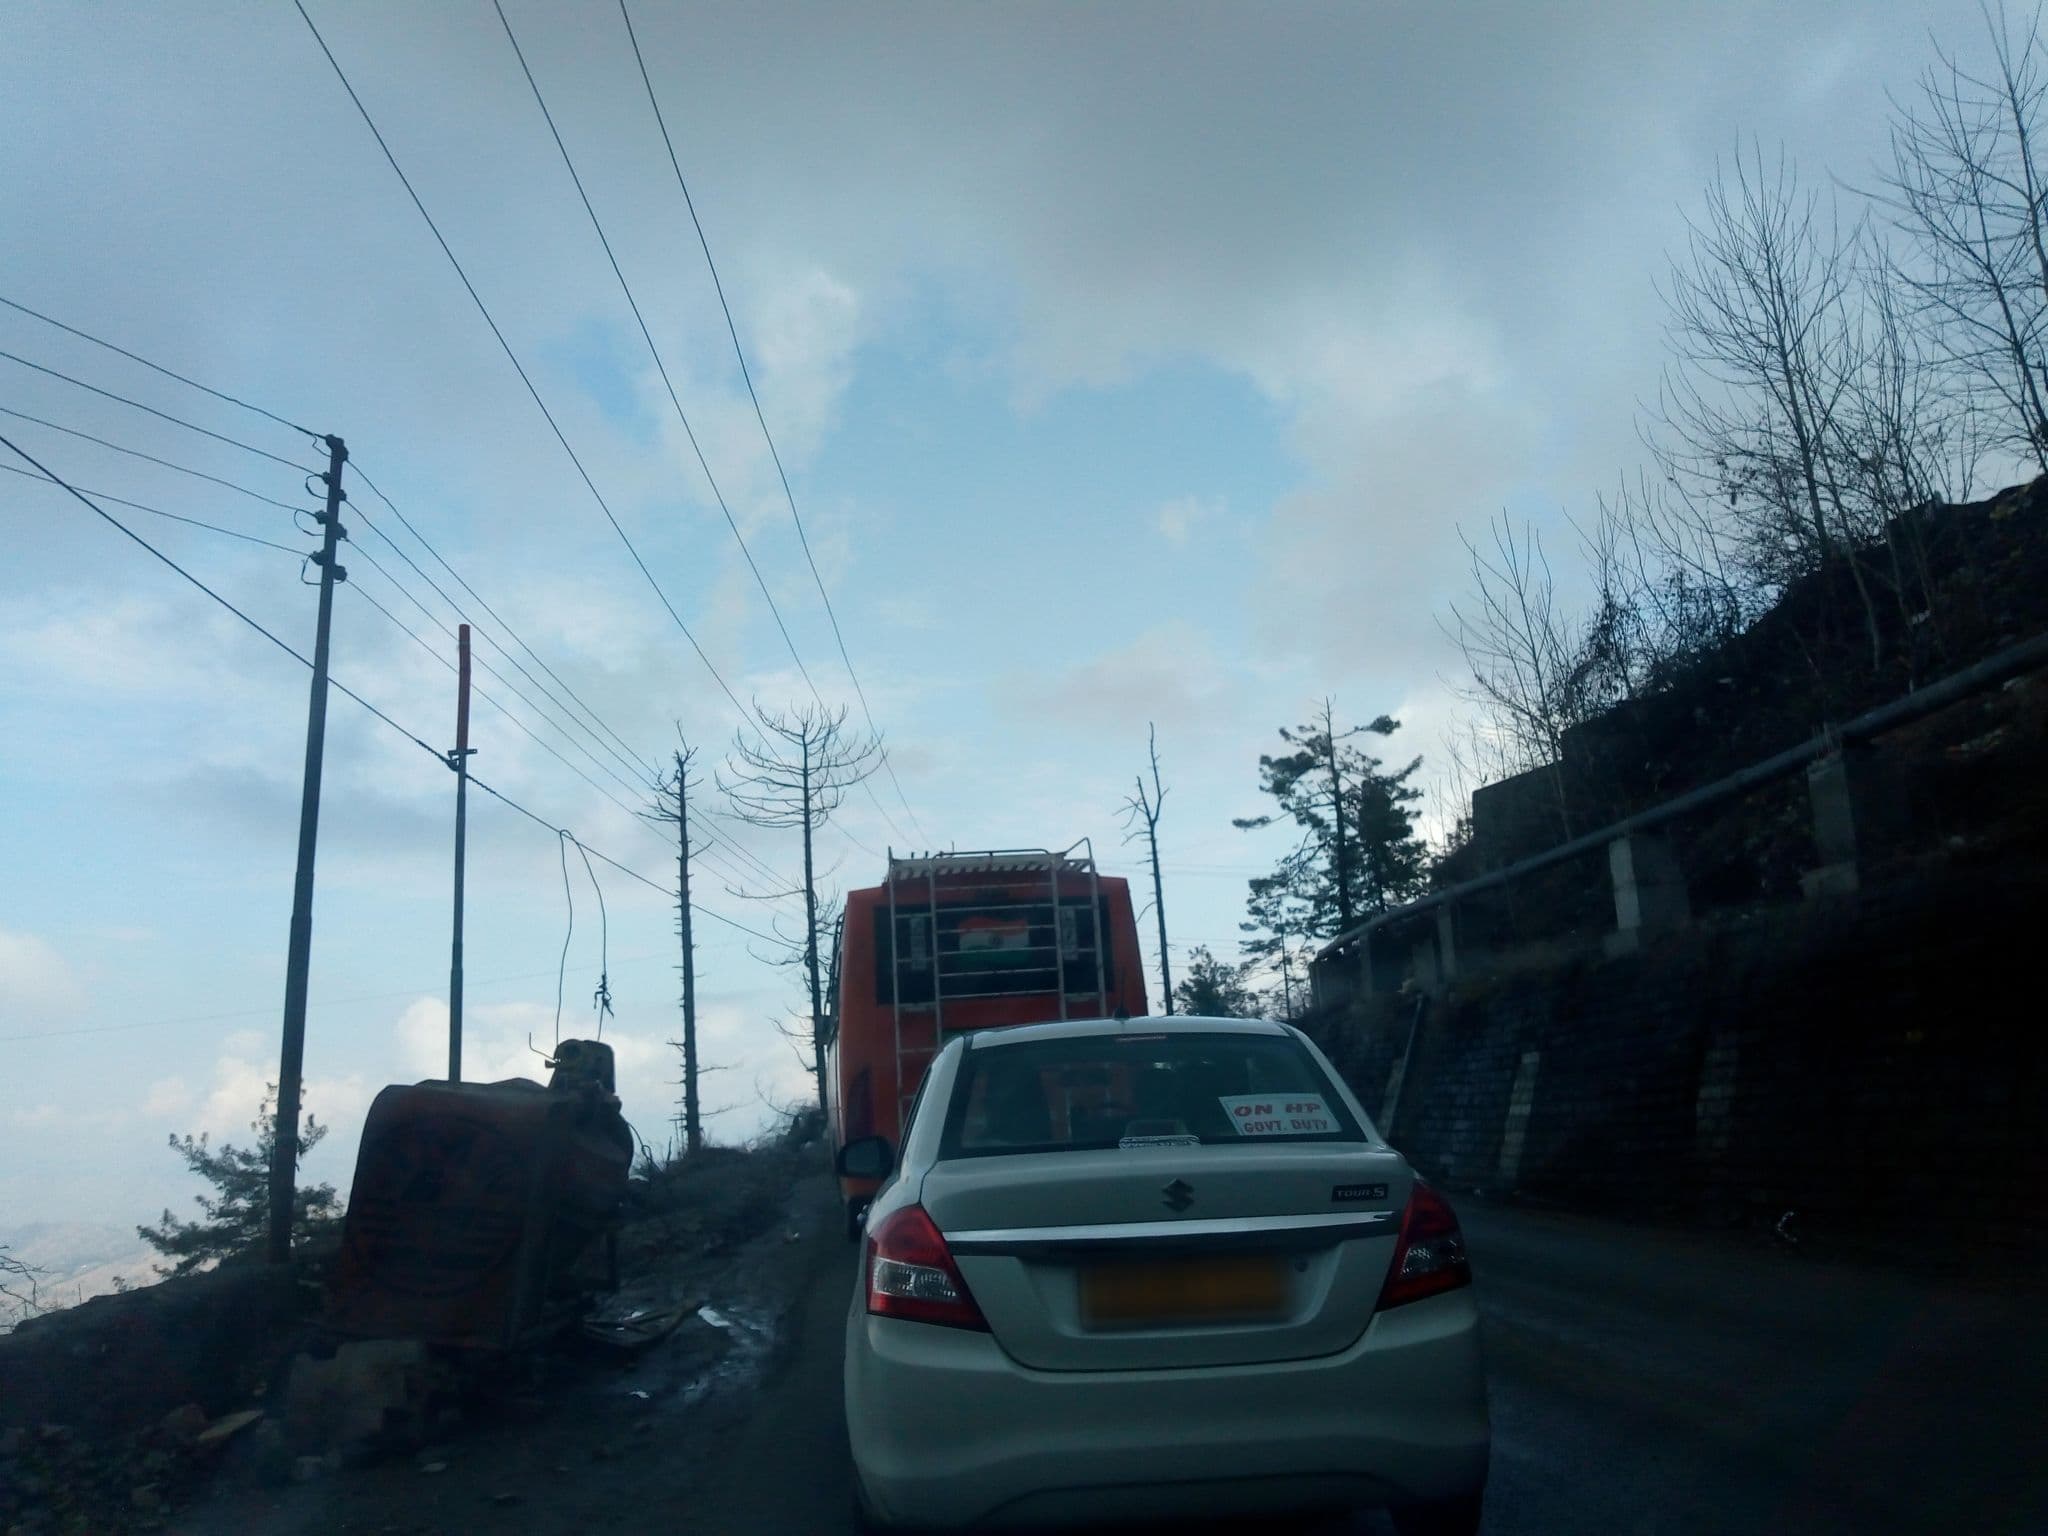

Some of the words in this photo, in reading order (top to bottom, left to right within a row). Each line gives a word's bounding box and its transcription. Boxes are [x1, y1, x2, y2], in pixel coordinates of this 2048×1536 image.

[1234, 1104, 1273, 1117] ON
[1285, 1103, 1320, 1113] HP
[1291, 1119, 1328, 1130] DUTY
